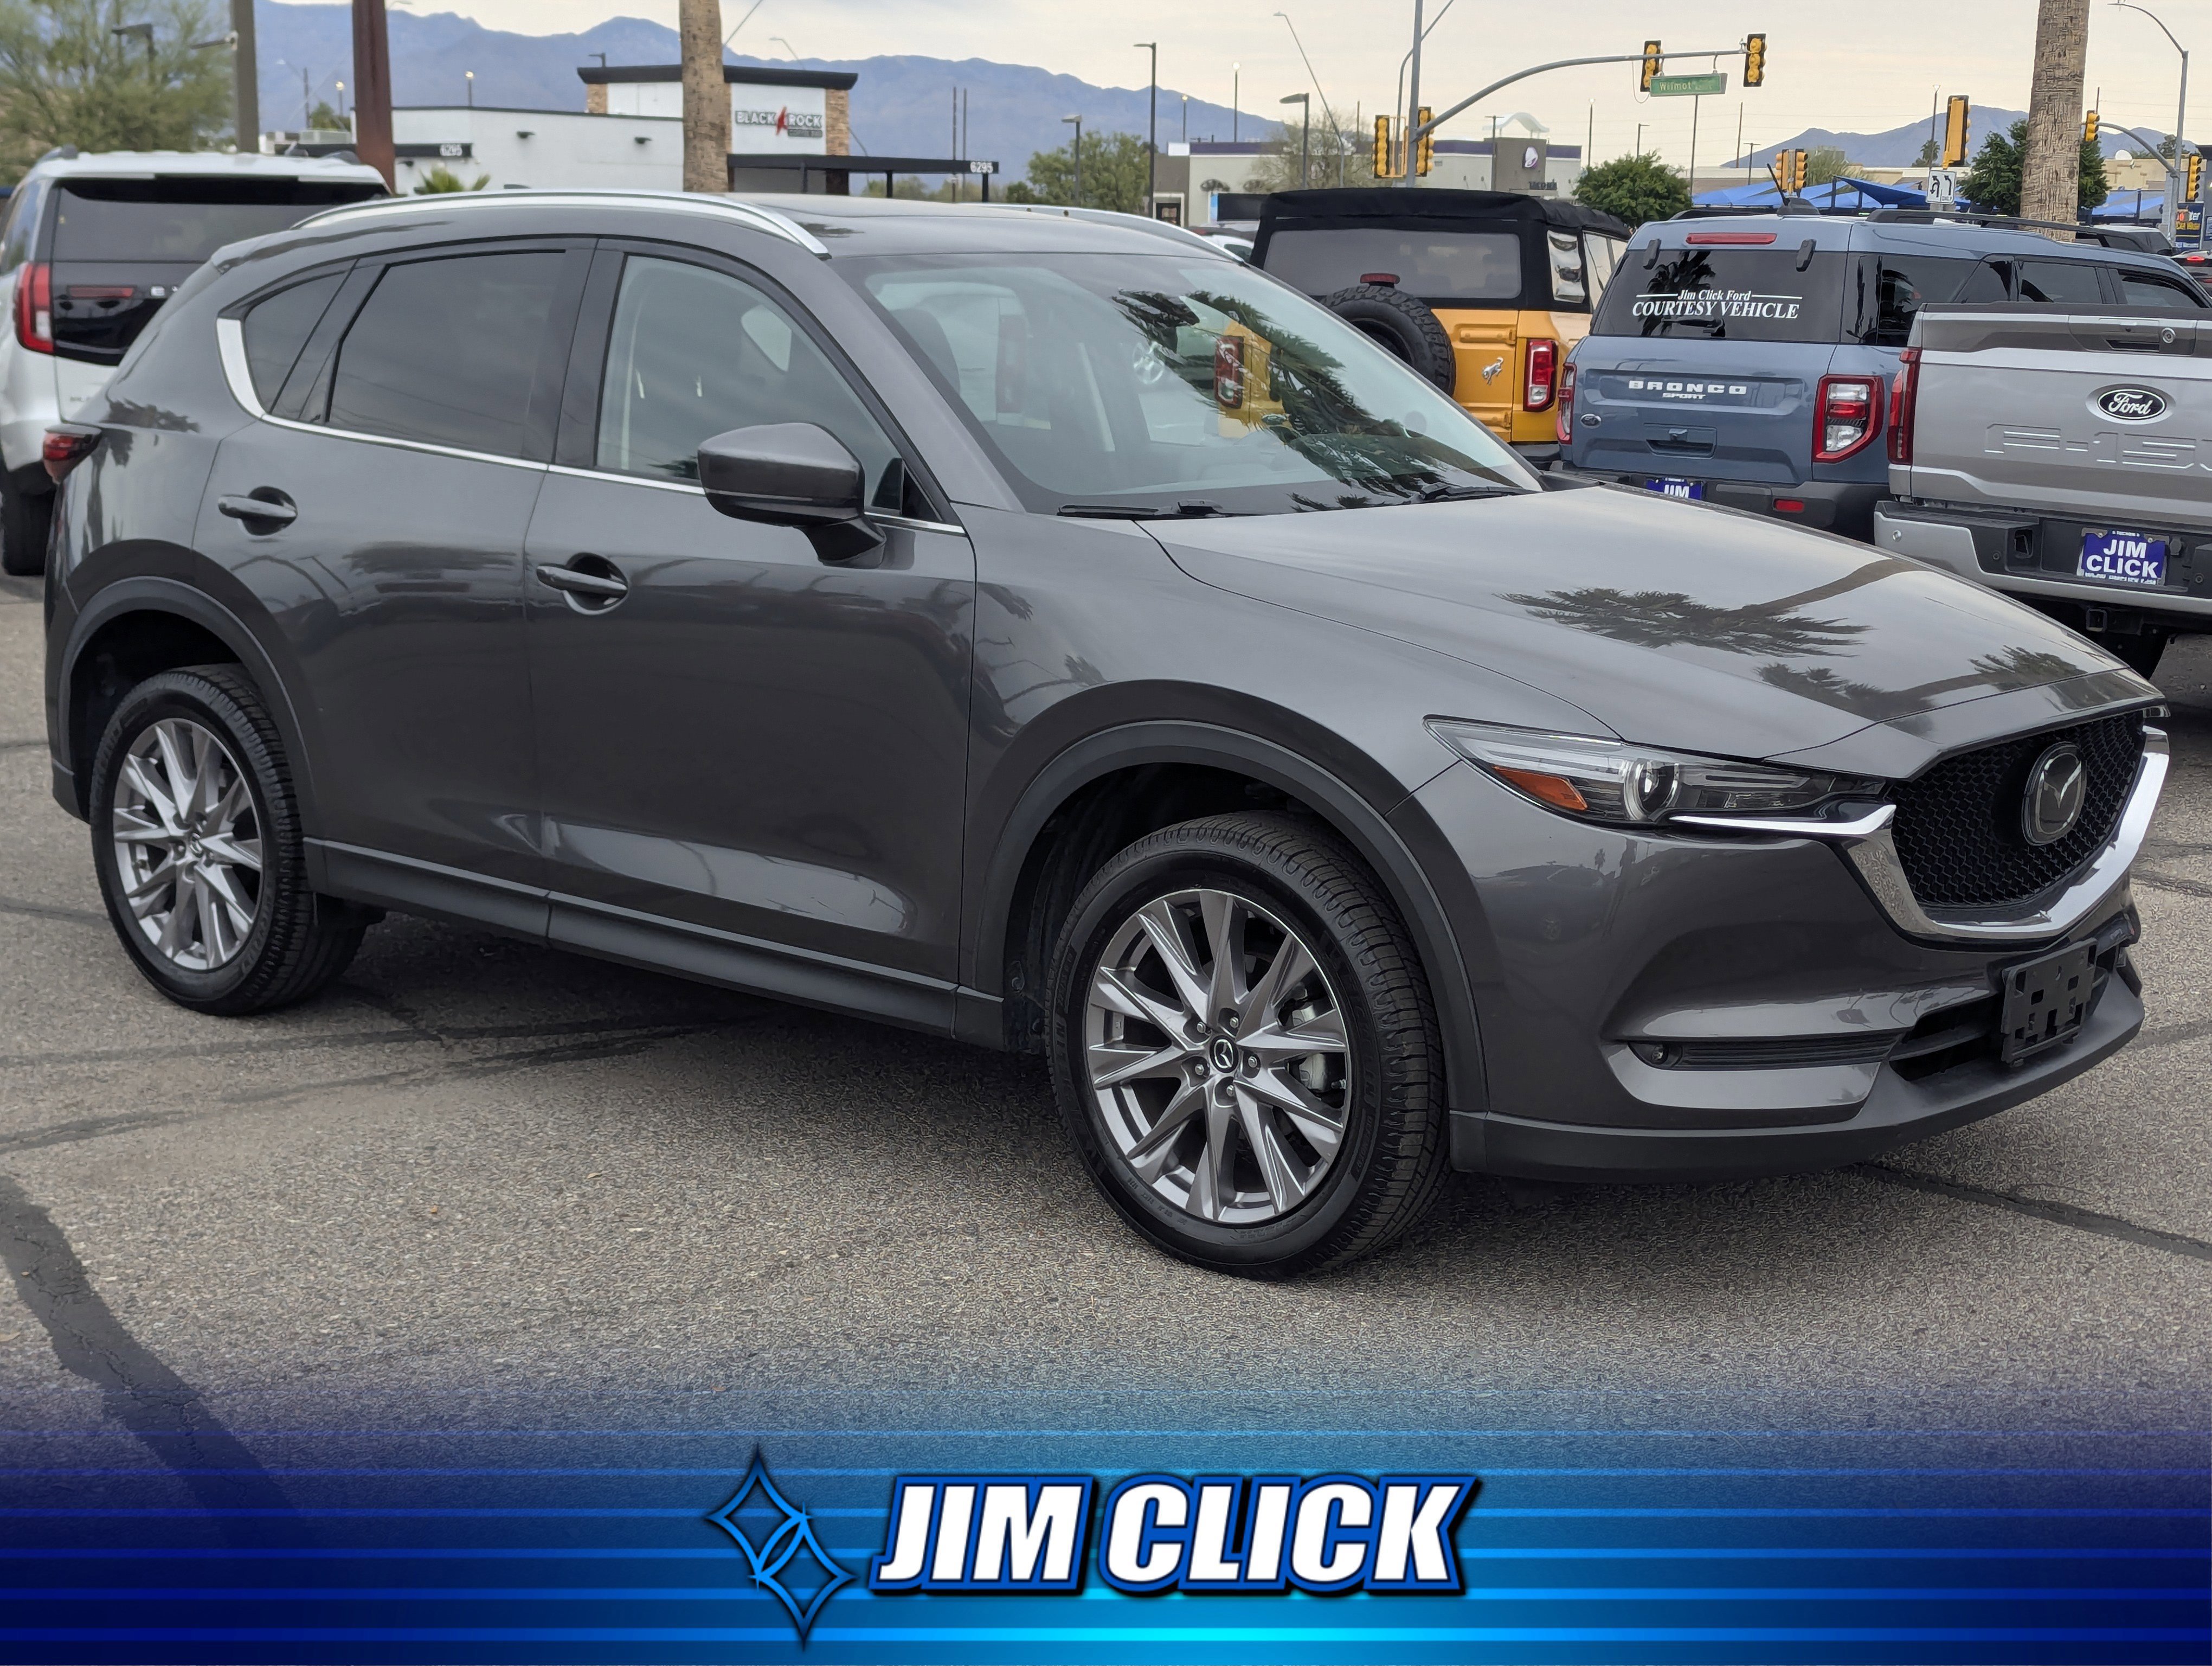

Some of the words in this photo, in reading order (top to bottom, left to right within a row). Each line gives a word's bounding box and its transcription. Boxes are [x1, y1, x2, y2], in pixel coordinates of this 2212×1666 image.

[1659, 82, 1692, 91] Wilmot
[736, 111, 776, 125] BLACK
[788, 114, 822, 127] ROCK
[970, 161, 993, 174] 6295
[1677, 290, 1696, 300] Jim
[1698, 290, 1723, 300] Click
[1726, 290, 1752, 301] Ford
[1632, 300, 1719, 317] COURTESY
[1720, 302, 1800, 319] VEHICLE
[1628, 380, 1747, 395] BRONCO
[2108, 392, 2153, 415] Ford
[1984, 423, 2212, 471] F-15
[2102, 539, 2147, 559] JIM
[2086, 554, 2159, 579] CLICK
